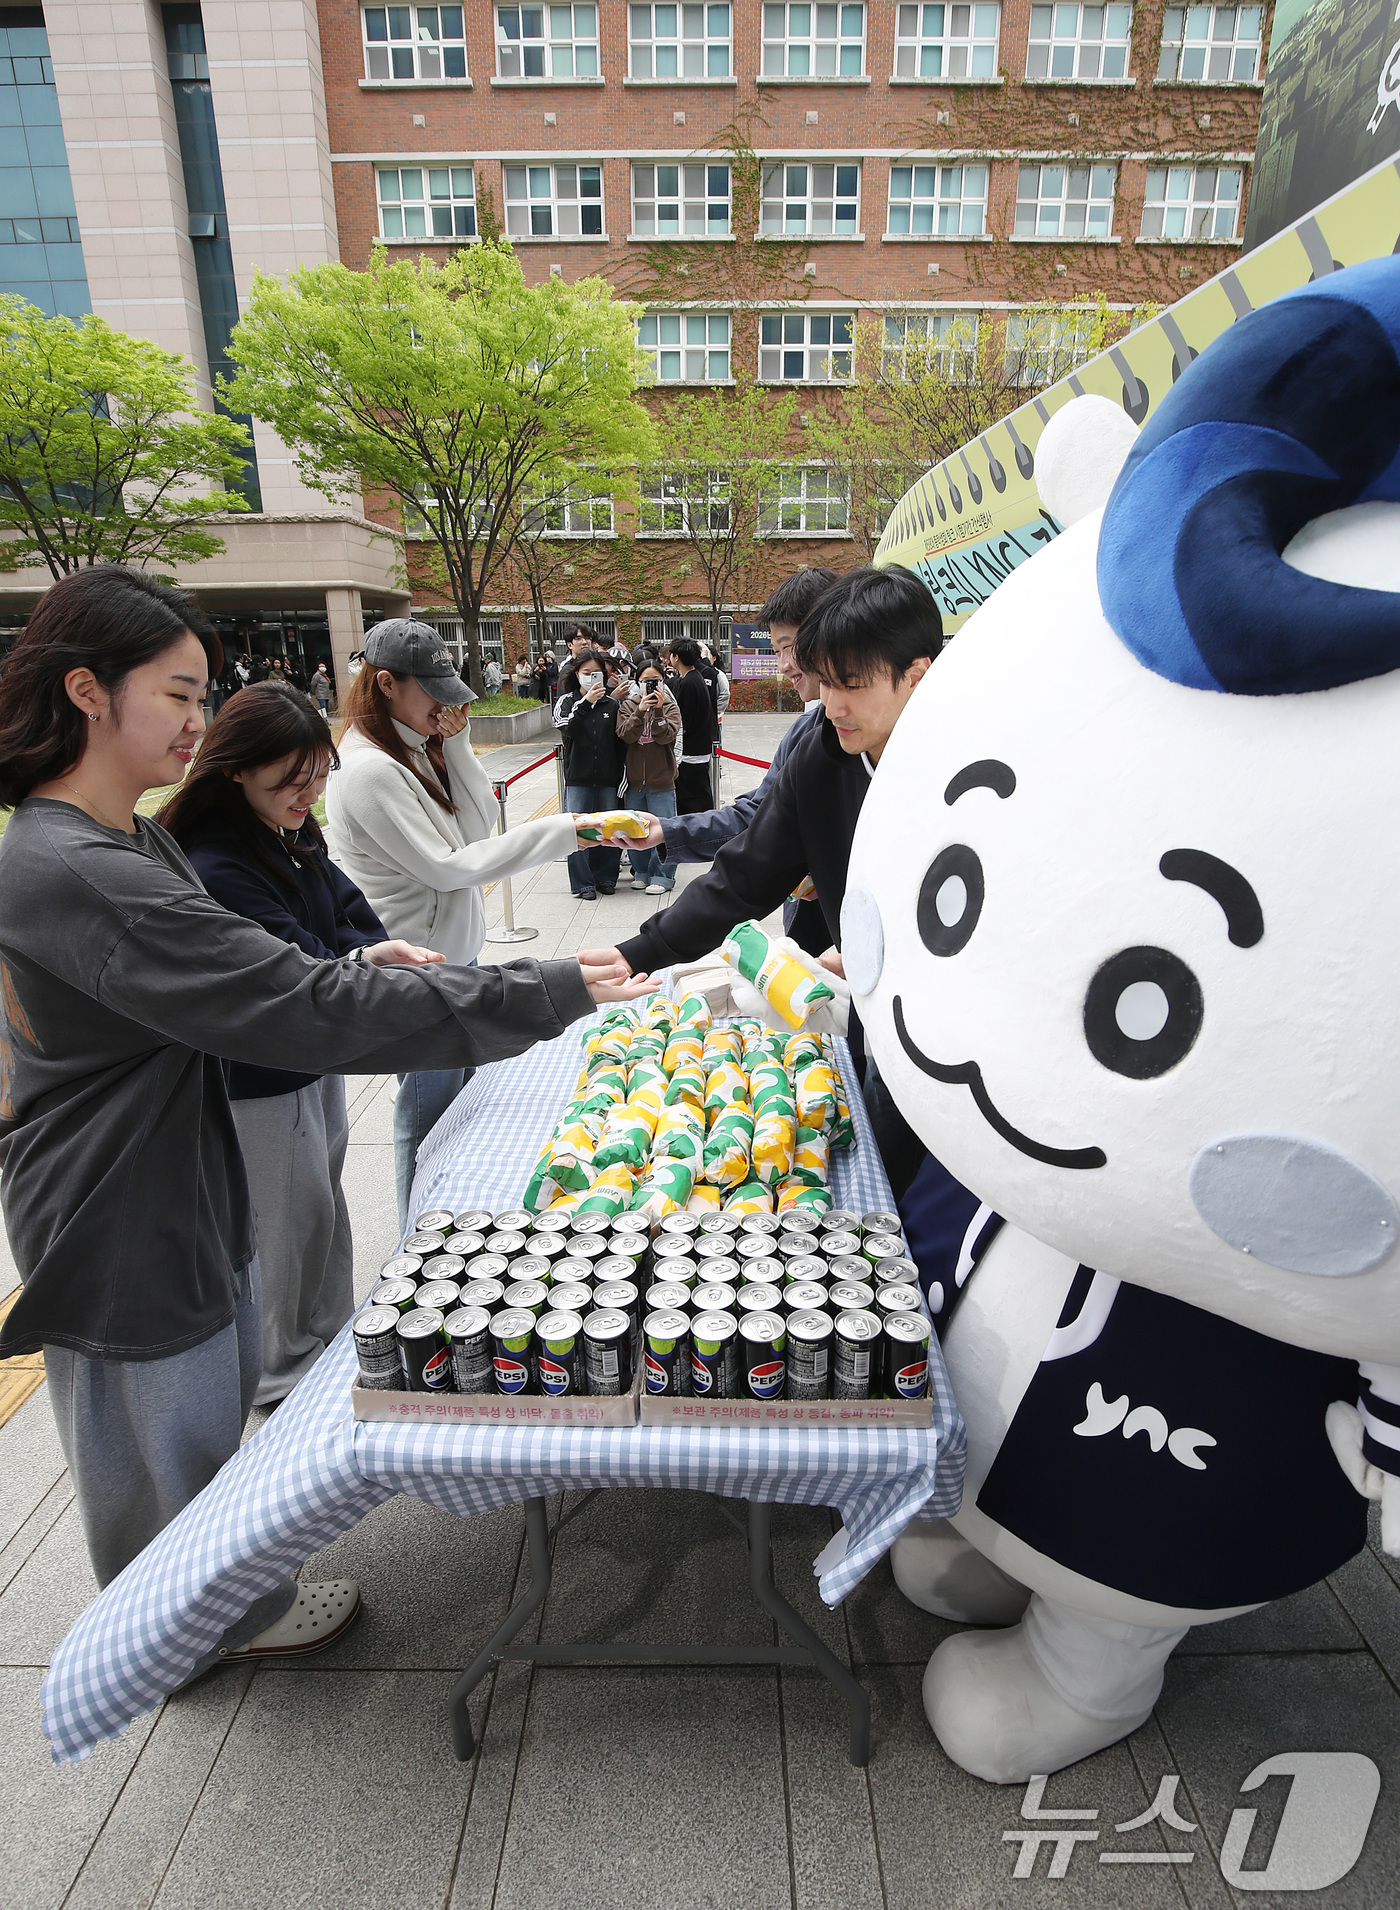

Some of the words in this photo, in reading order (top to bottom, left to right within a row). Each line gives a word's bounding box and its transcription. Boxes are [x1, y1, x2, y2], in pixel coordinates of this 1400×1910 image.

[425, 1360, 449, 1379] PEP
[647, 1369, 665, 1382] PSI
[541, 1370, 566, 1383] EPSI
[478, 1406, 501, 1418] 특성
[504, 1407, 516, 1419] 상
[765, 1408, 788, 1419] 특성
[793, 1408, 805, 1419] 상
